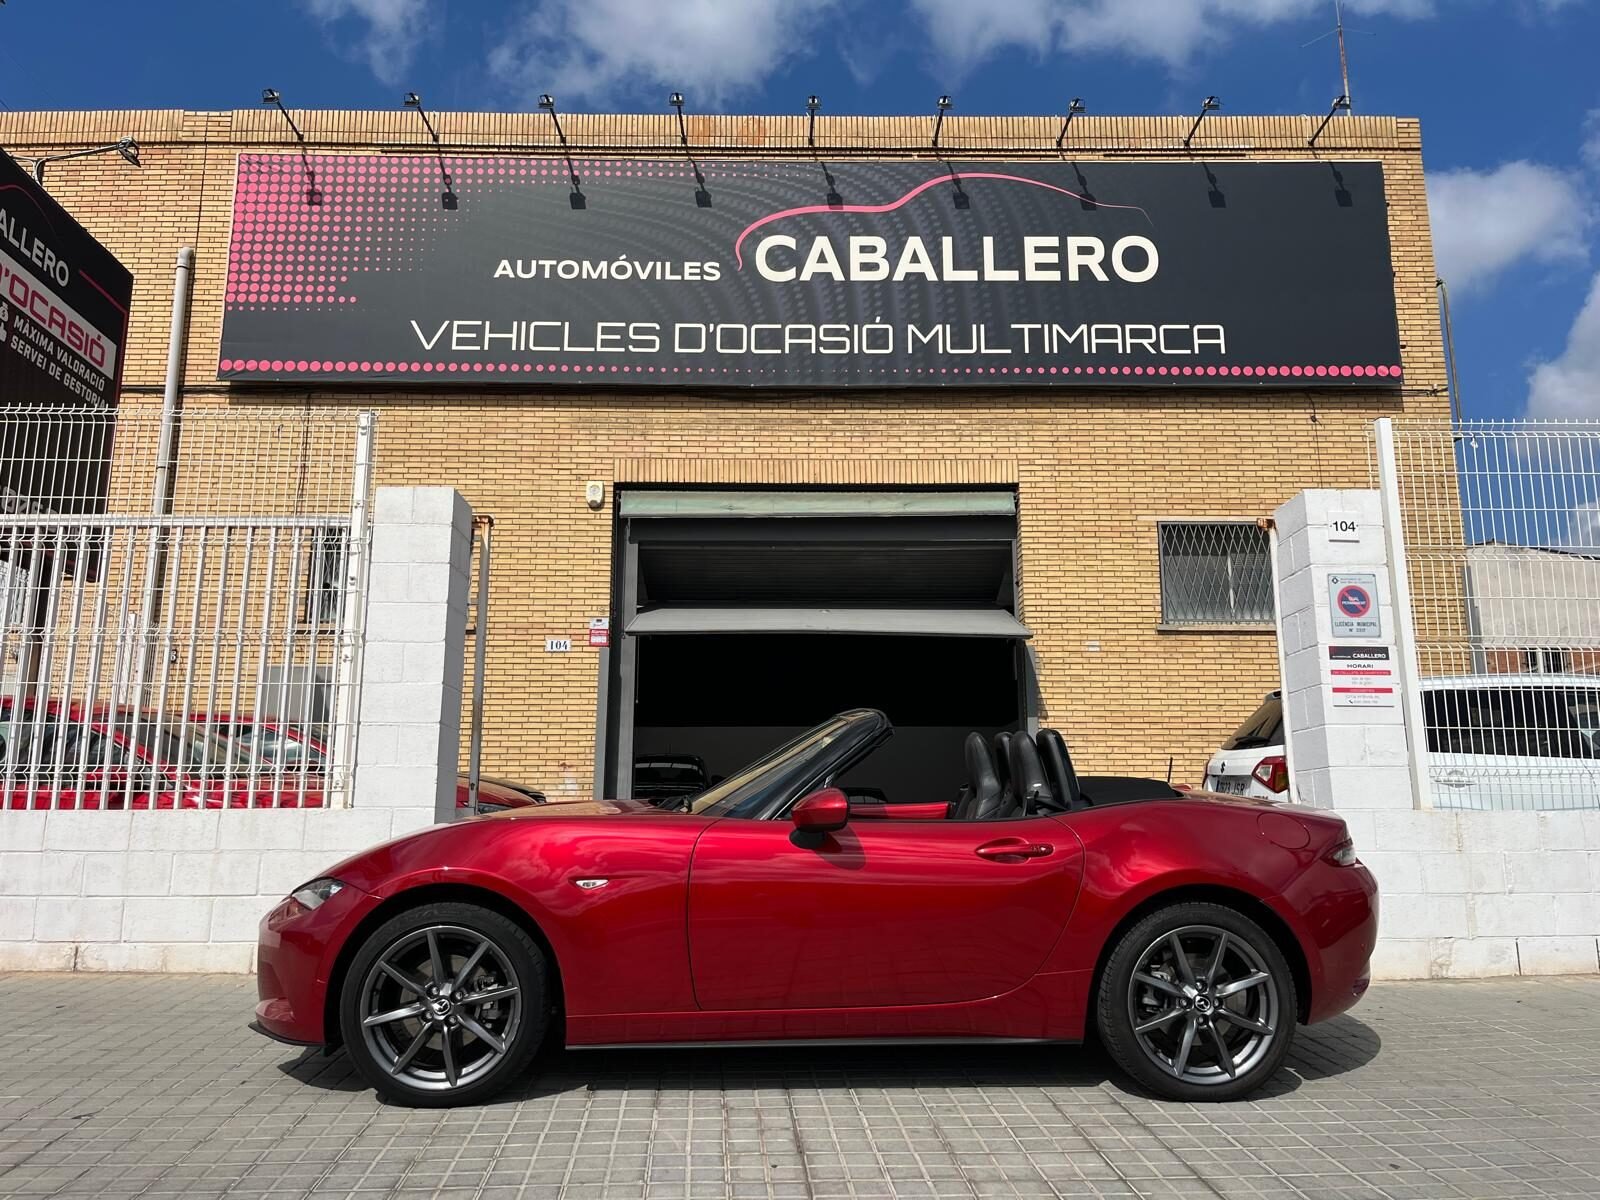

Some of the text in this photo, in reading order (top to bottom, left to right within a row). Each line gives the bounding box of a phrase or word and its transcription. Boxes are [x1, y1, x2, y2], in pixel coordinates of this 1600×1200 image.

[494, 234, 1160, 283] AUTOMÓVILES CABALLERO
[0, 261, 105, 367] 'OCASIÓ
[410, 317, 1226, 354] VEHICLES D'OCASIÓ MULTIMARCA
[10, 335, 47, 370] SERVEI
[48, 361, 62, 380] DE
[57, 346, 105, 392] VALORACIÓ
[1332, 521, 1356, 532] 104
[550, 640, 568, 650] 104
